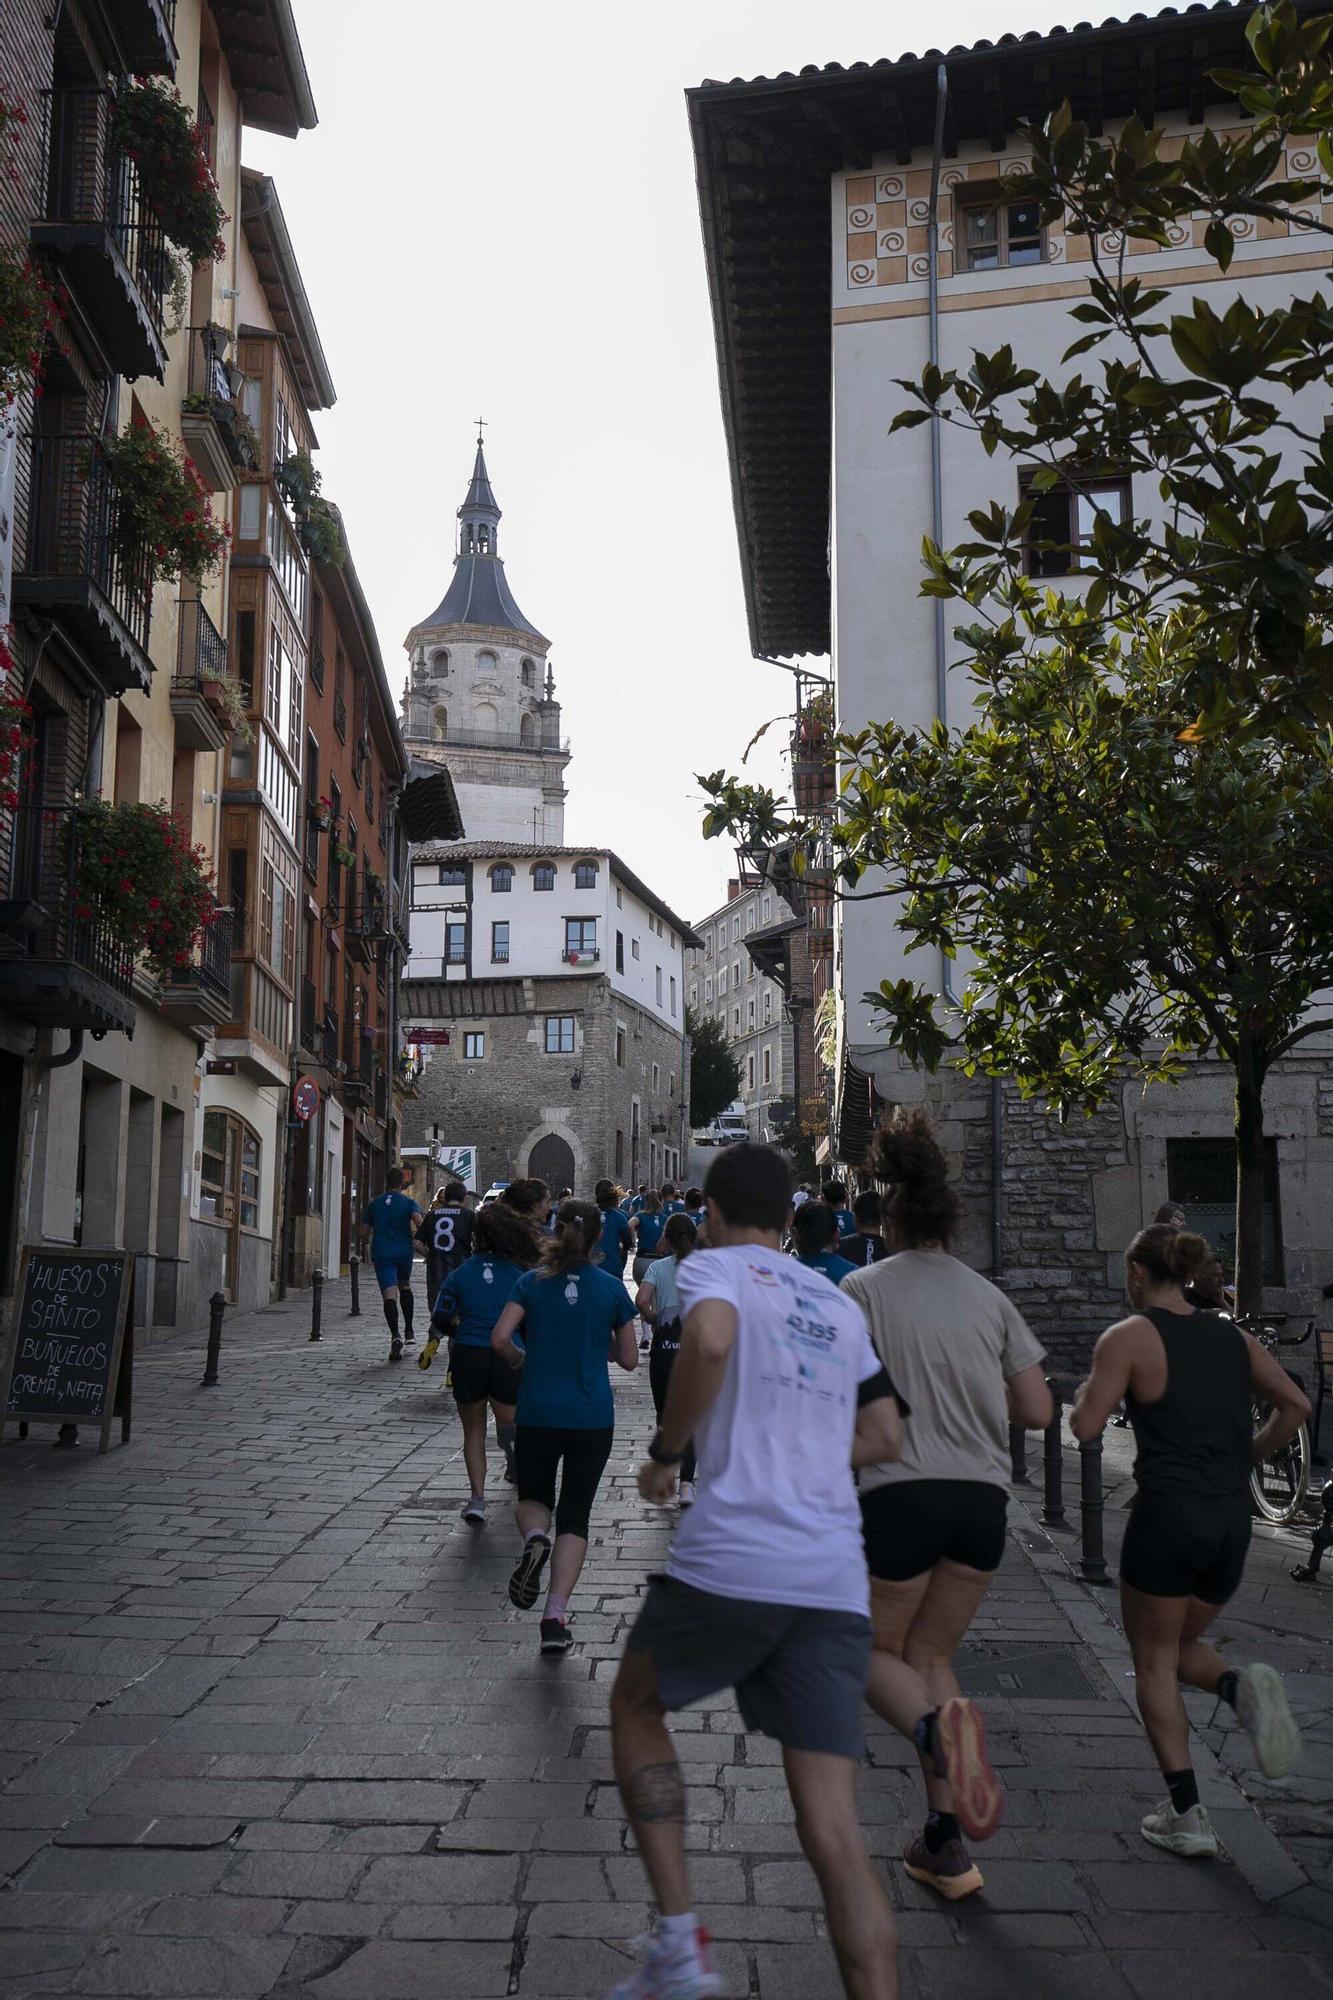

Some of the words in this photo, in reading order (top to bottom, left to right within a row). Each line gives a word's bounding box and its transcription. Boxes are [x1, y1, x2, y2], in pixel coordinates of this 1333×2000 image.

[434, 1216, 455, 1252] 8
[33, 1264, 109, 1298] HUESOS
[29, 1299, 100, 1329] SANTO
[54, 1293, 69, 1306] DE
[21, 1337, 108, 1370] BUÑUELOS
[47, 1365, 61, 1377] DE
[12, 1374, 57, 1396] CREMA
[66, 1380, 104, 1401] NATA
